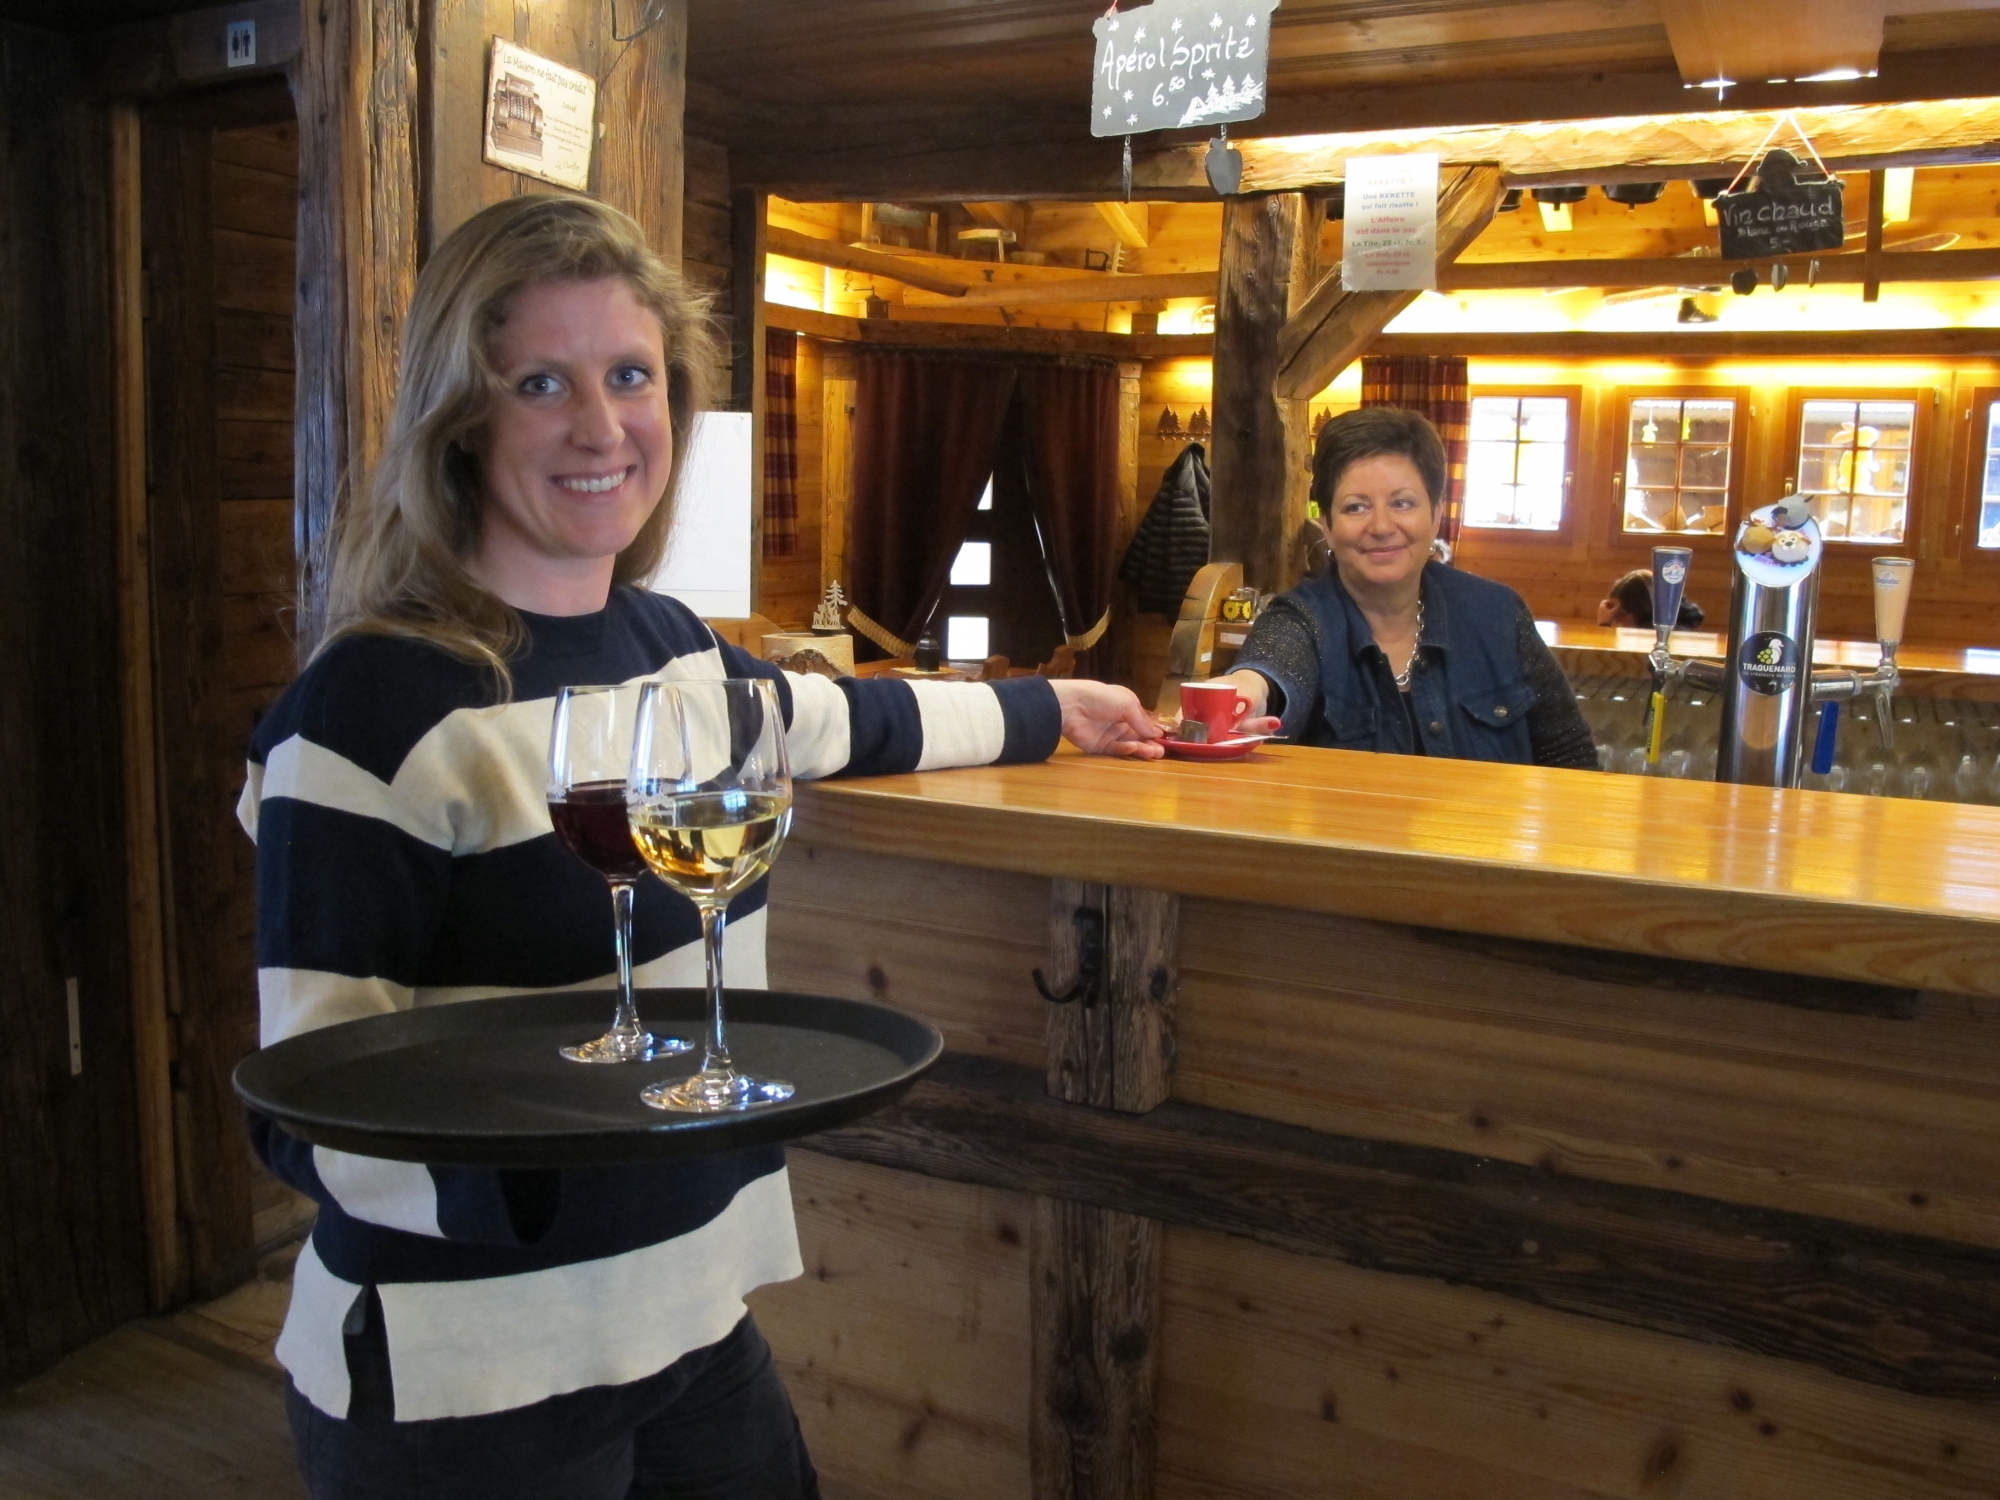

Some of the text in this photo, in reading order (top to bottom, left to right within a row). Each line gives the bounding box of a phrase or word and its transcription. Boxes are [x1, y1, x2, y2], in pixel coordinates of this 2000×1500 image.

[1169, 25, 1255, 80] Spritz
[503, 51, 587, 96] La Maison ne fait pas crédit
[561, 101, 578, 114] Sauf
[1379, 191, 1416, 199] KEKETTE
[1361, 203, 1373, 211] qui
[1388, 201, 1414, 209] risette
[1370, 216, 1405, 224] L'Affaire
[1723, 202, 1754, 227] Vin
[1370, 227, 1391, 235] dans
[1392, 226, 1400, 234] le
[1789, 219, 1830, 234] Rouge
[1382, 239, 1392, 247] 25
[1742, 662, 1796, 674] TRAQUENARD
